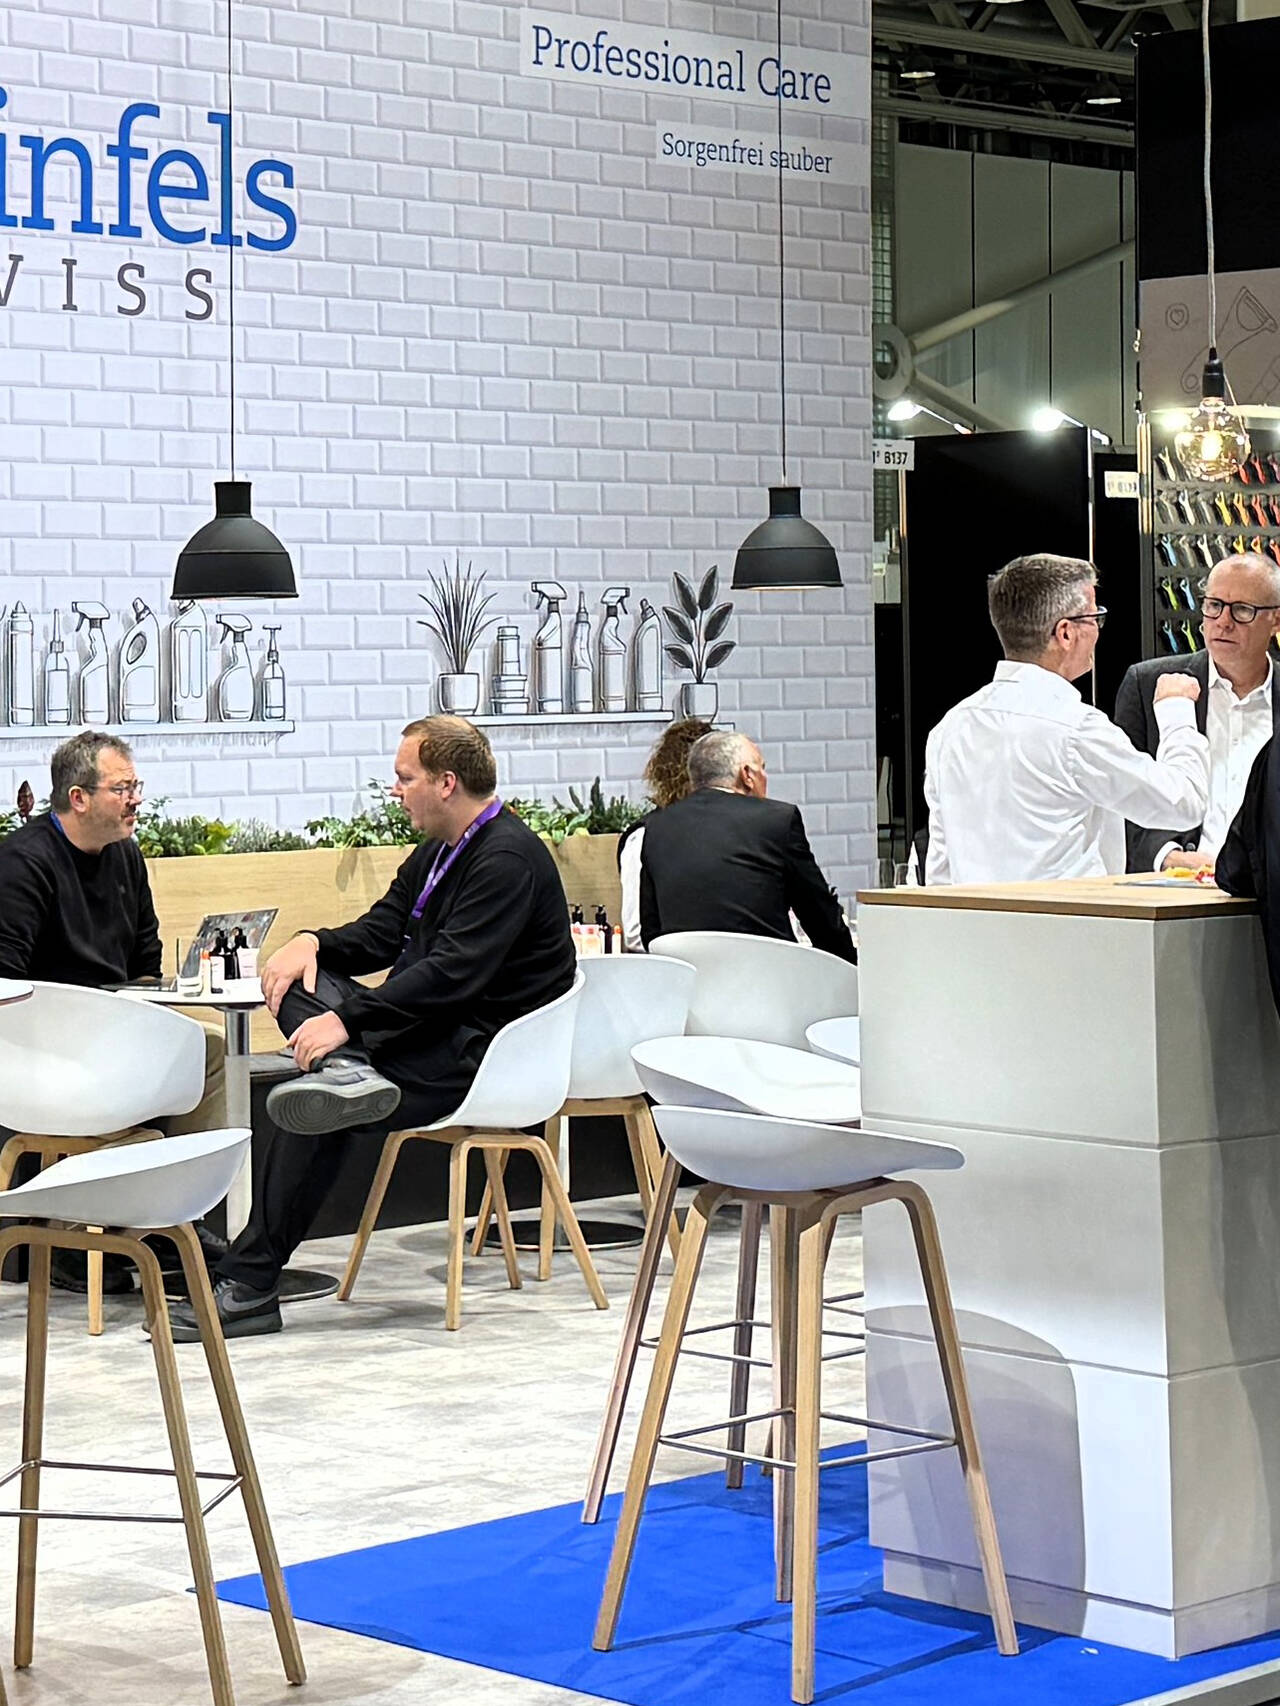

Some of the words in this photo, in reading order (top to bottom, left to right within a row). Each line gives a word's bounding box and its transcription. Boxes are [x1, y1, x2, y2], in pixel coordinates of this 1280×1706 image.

[532, 25, 746, 92] Professional
[758, 57, 832, 102] Care
[663, 132, 764, 167] Sorgenfrei
[770, 146, 833, 174] sauber
[884, 451, 908, 465] B137
